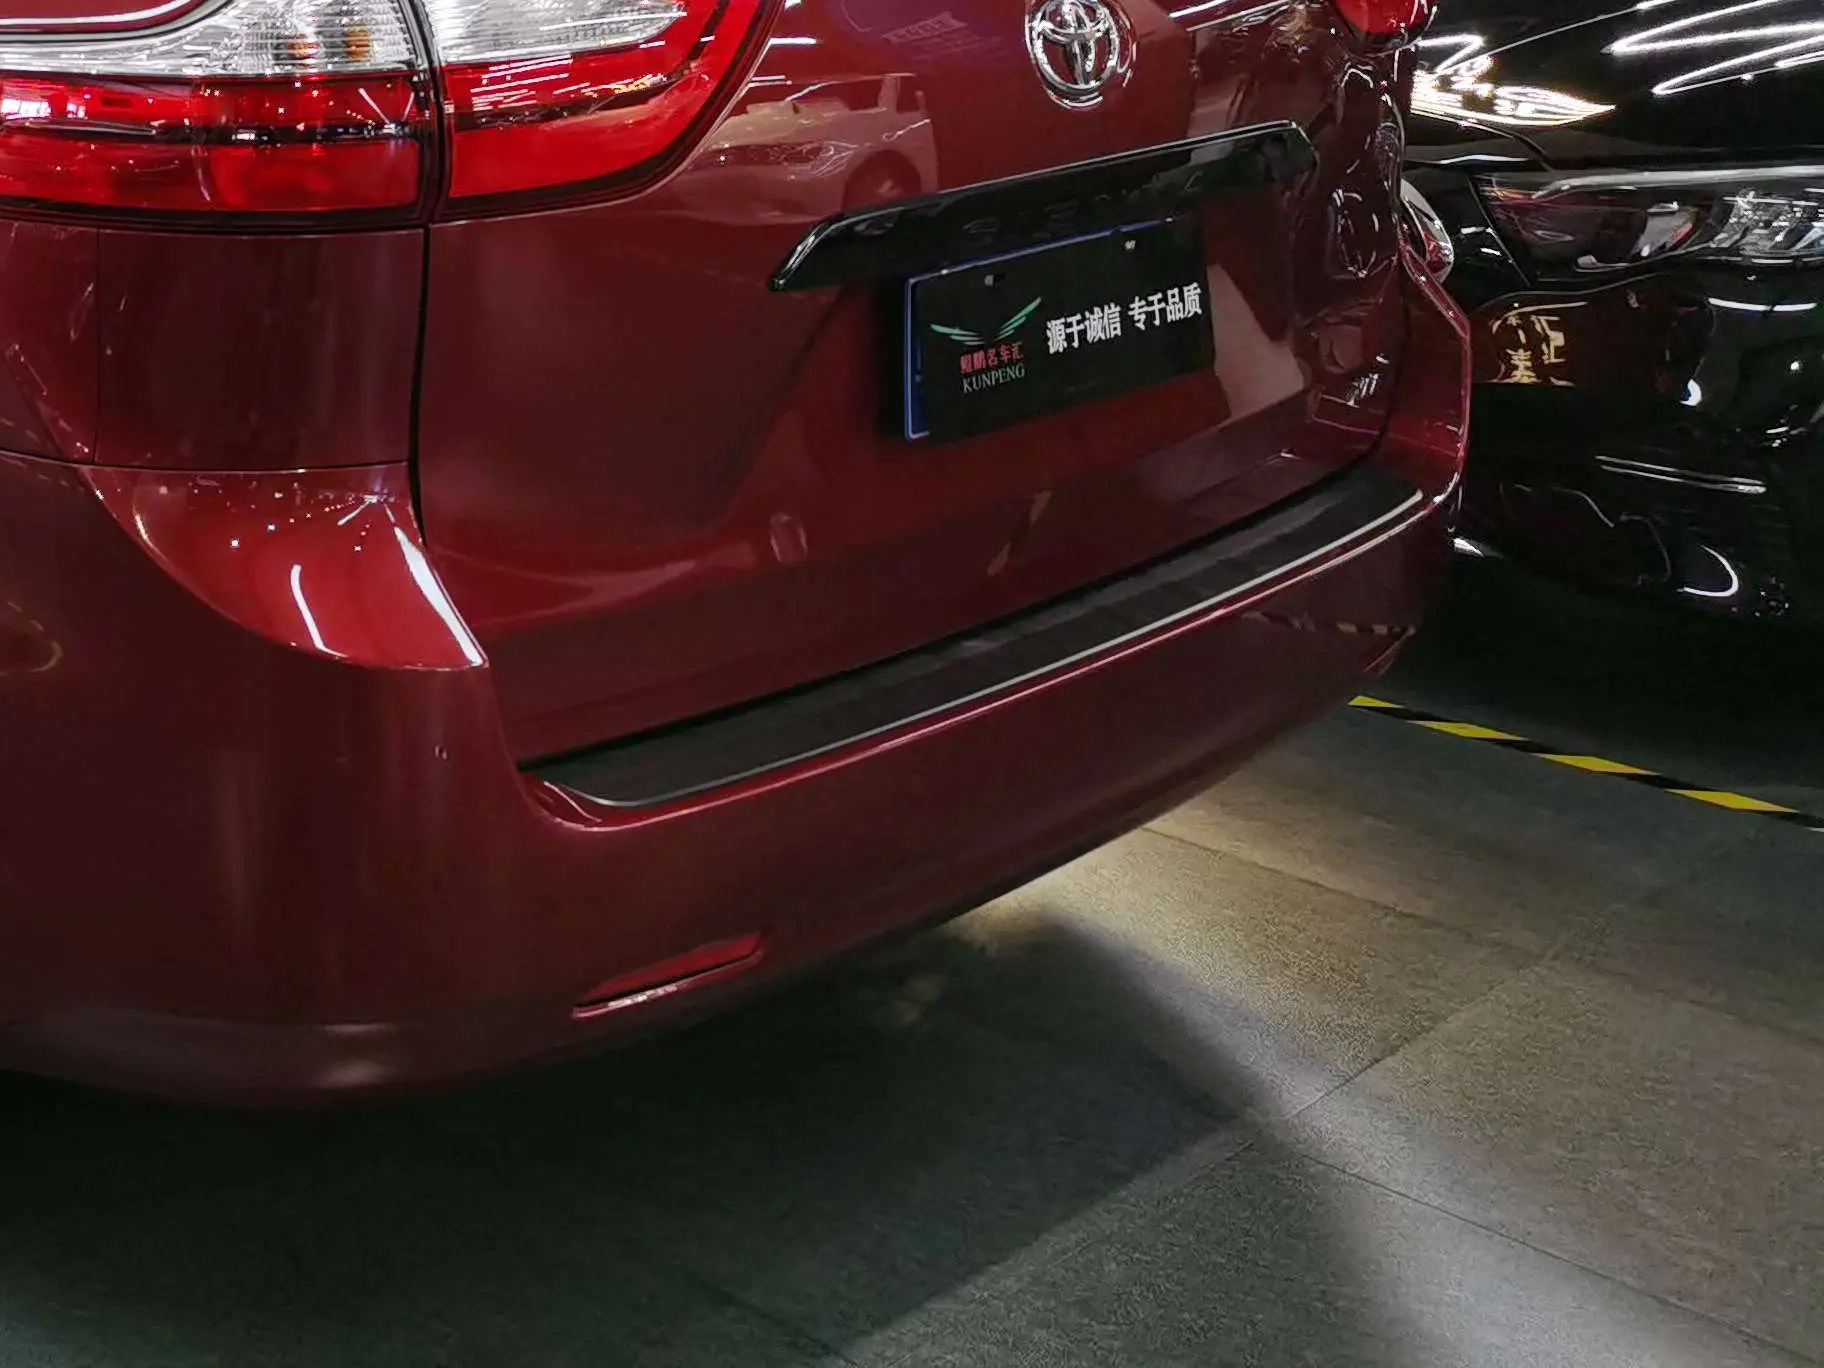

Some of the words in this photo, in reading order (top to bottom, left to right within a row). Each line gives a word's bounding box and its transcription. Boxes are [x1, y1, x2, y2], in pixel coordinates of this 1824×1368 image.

[1046, 302, 1122, 354] 源于诚信
[1128, 282, 1203, 331] 专于品质
[962, 362, 1026, 394] KUNPENG
